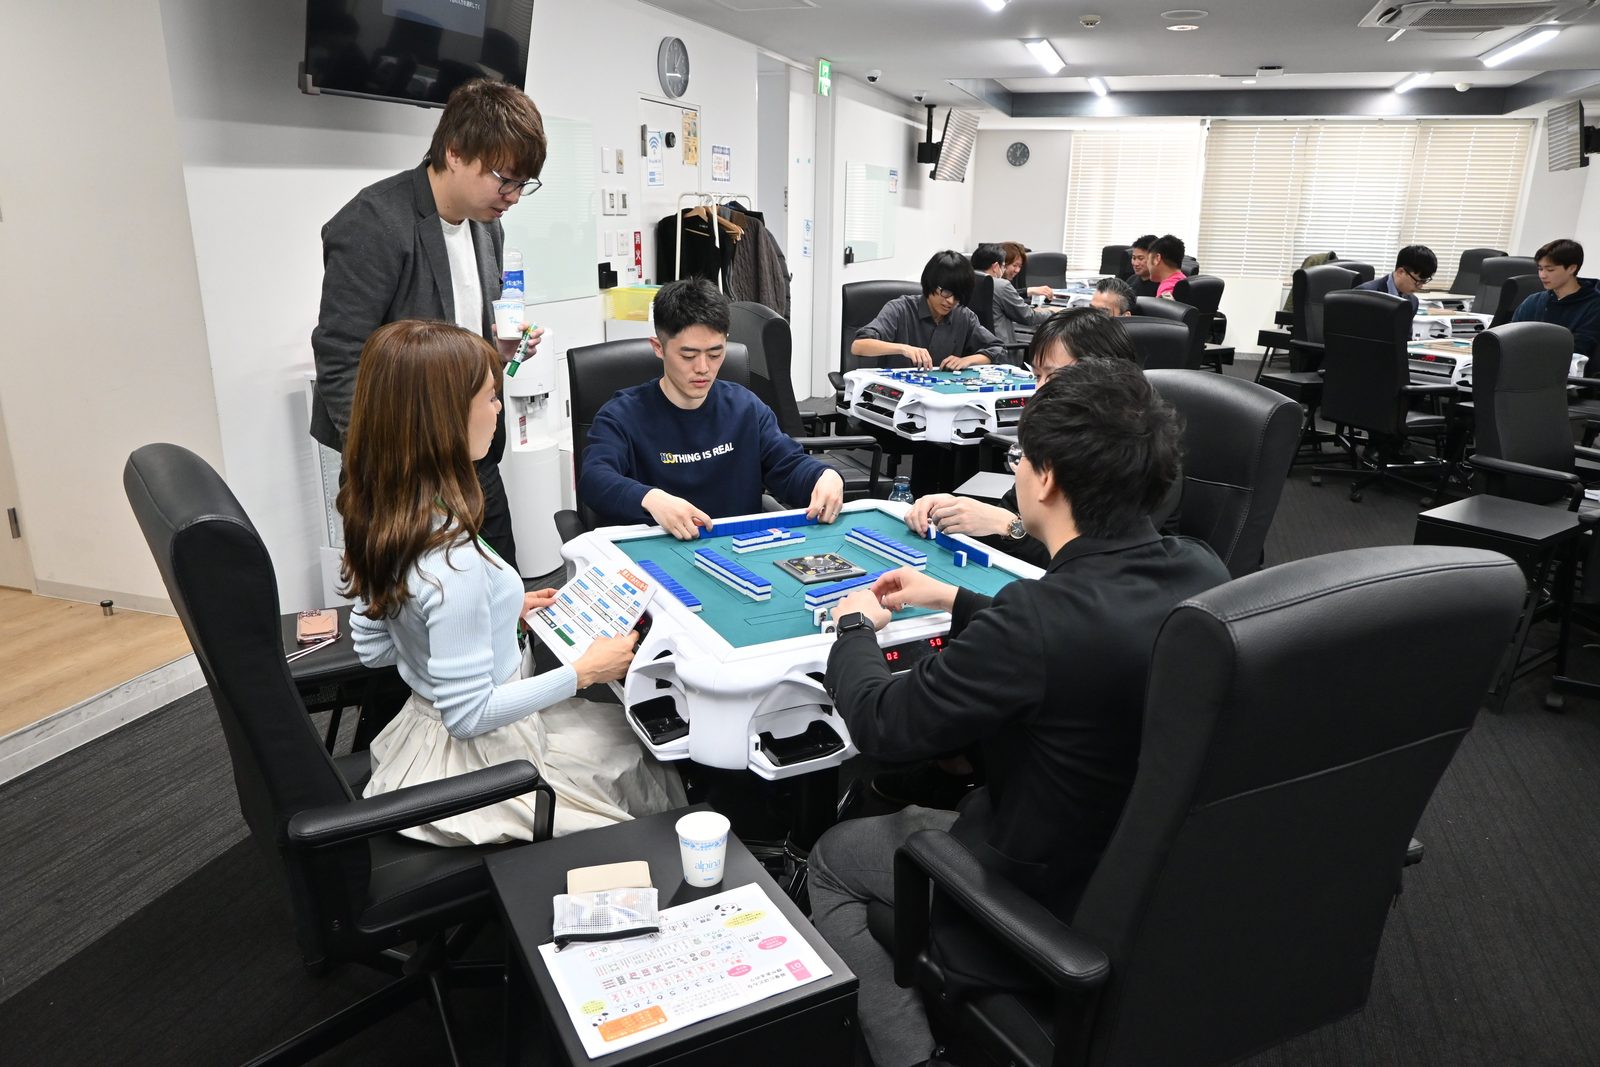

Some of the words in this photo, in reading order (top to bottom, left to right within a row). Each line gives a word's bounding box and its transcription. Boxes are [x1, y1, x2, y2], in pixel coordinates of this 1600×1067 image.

[702, 450, 712, 460] IS
[712, 442, 734, 457] REAL
[929, 638, 942, 647] 50
[886, 651, 899, 661] 02
[694, 859, 721, 873] alpina
[788, 961, 803, 970] 01
